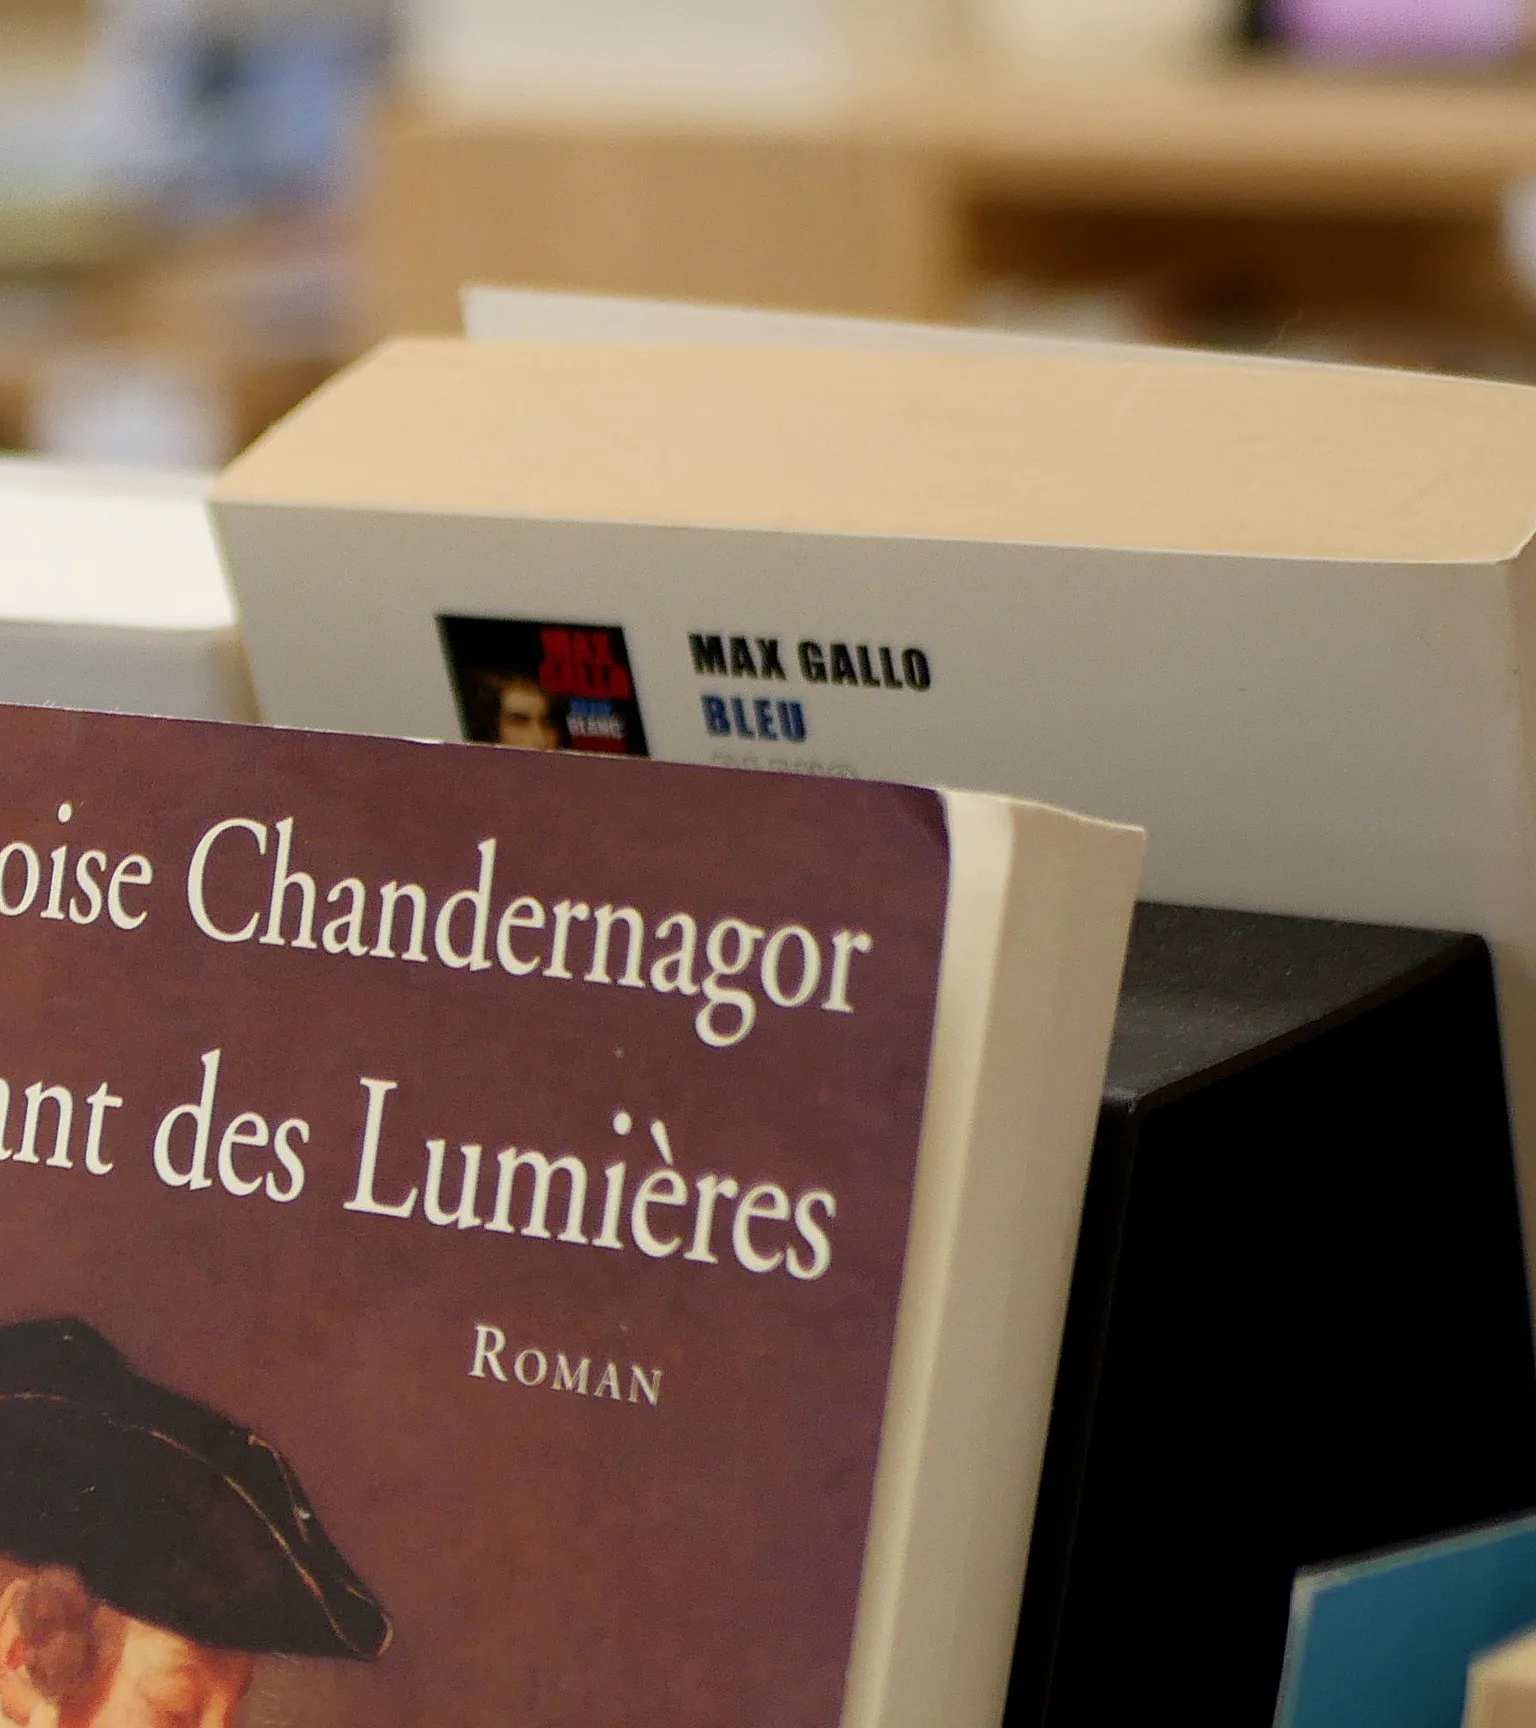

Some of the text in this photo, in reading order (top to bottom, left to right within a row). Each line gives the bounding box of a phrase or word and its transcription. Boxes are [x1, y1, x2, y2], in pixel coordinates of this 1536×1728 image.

[688, 631, 931, 692] MAX GALLO
[701, 694, 808, 743] BLEU
[187, 817, 872, 1046] Chandernagor
[153, 1048, 308, 1200] des
[343, 1078, 837, 1281] Lumières
[468, 1324, 663, 1407] ROMAN
